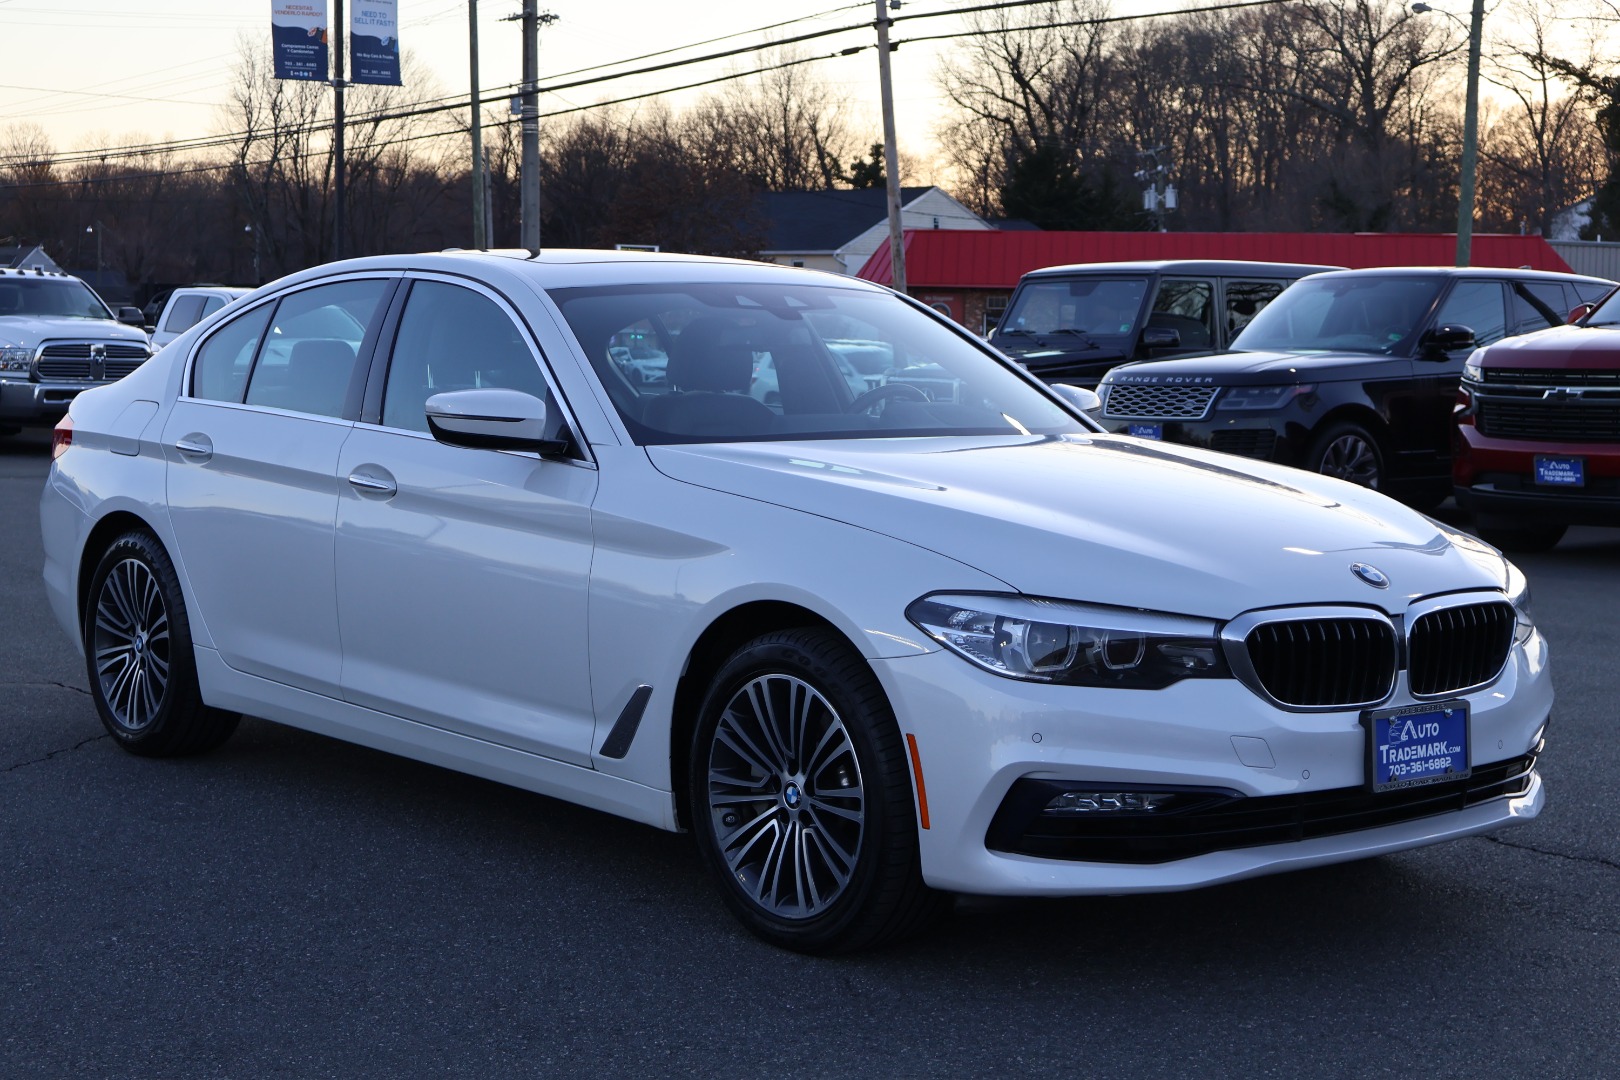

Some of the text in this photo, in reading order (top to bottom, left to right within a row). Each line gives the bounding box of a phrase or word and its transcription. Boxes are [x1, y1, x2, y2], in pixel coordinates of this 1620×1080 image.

[361, 10, 377, 18] NEED
[354, 17, 368, 25] SELL
[376, 19, 394, 27] FAST?
[1388, 756, 1452, 777] 703-361-6882
